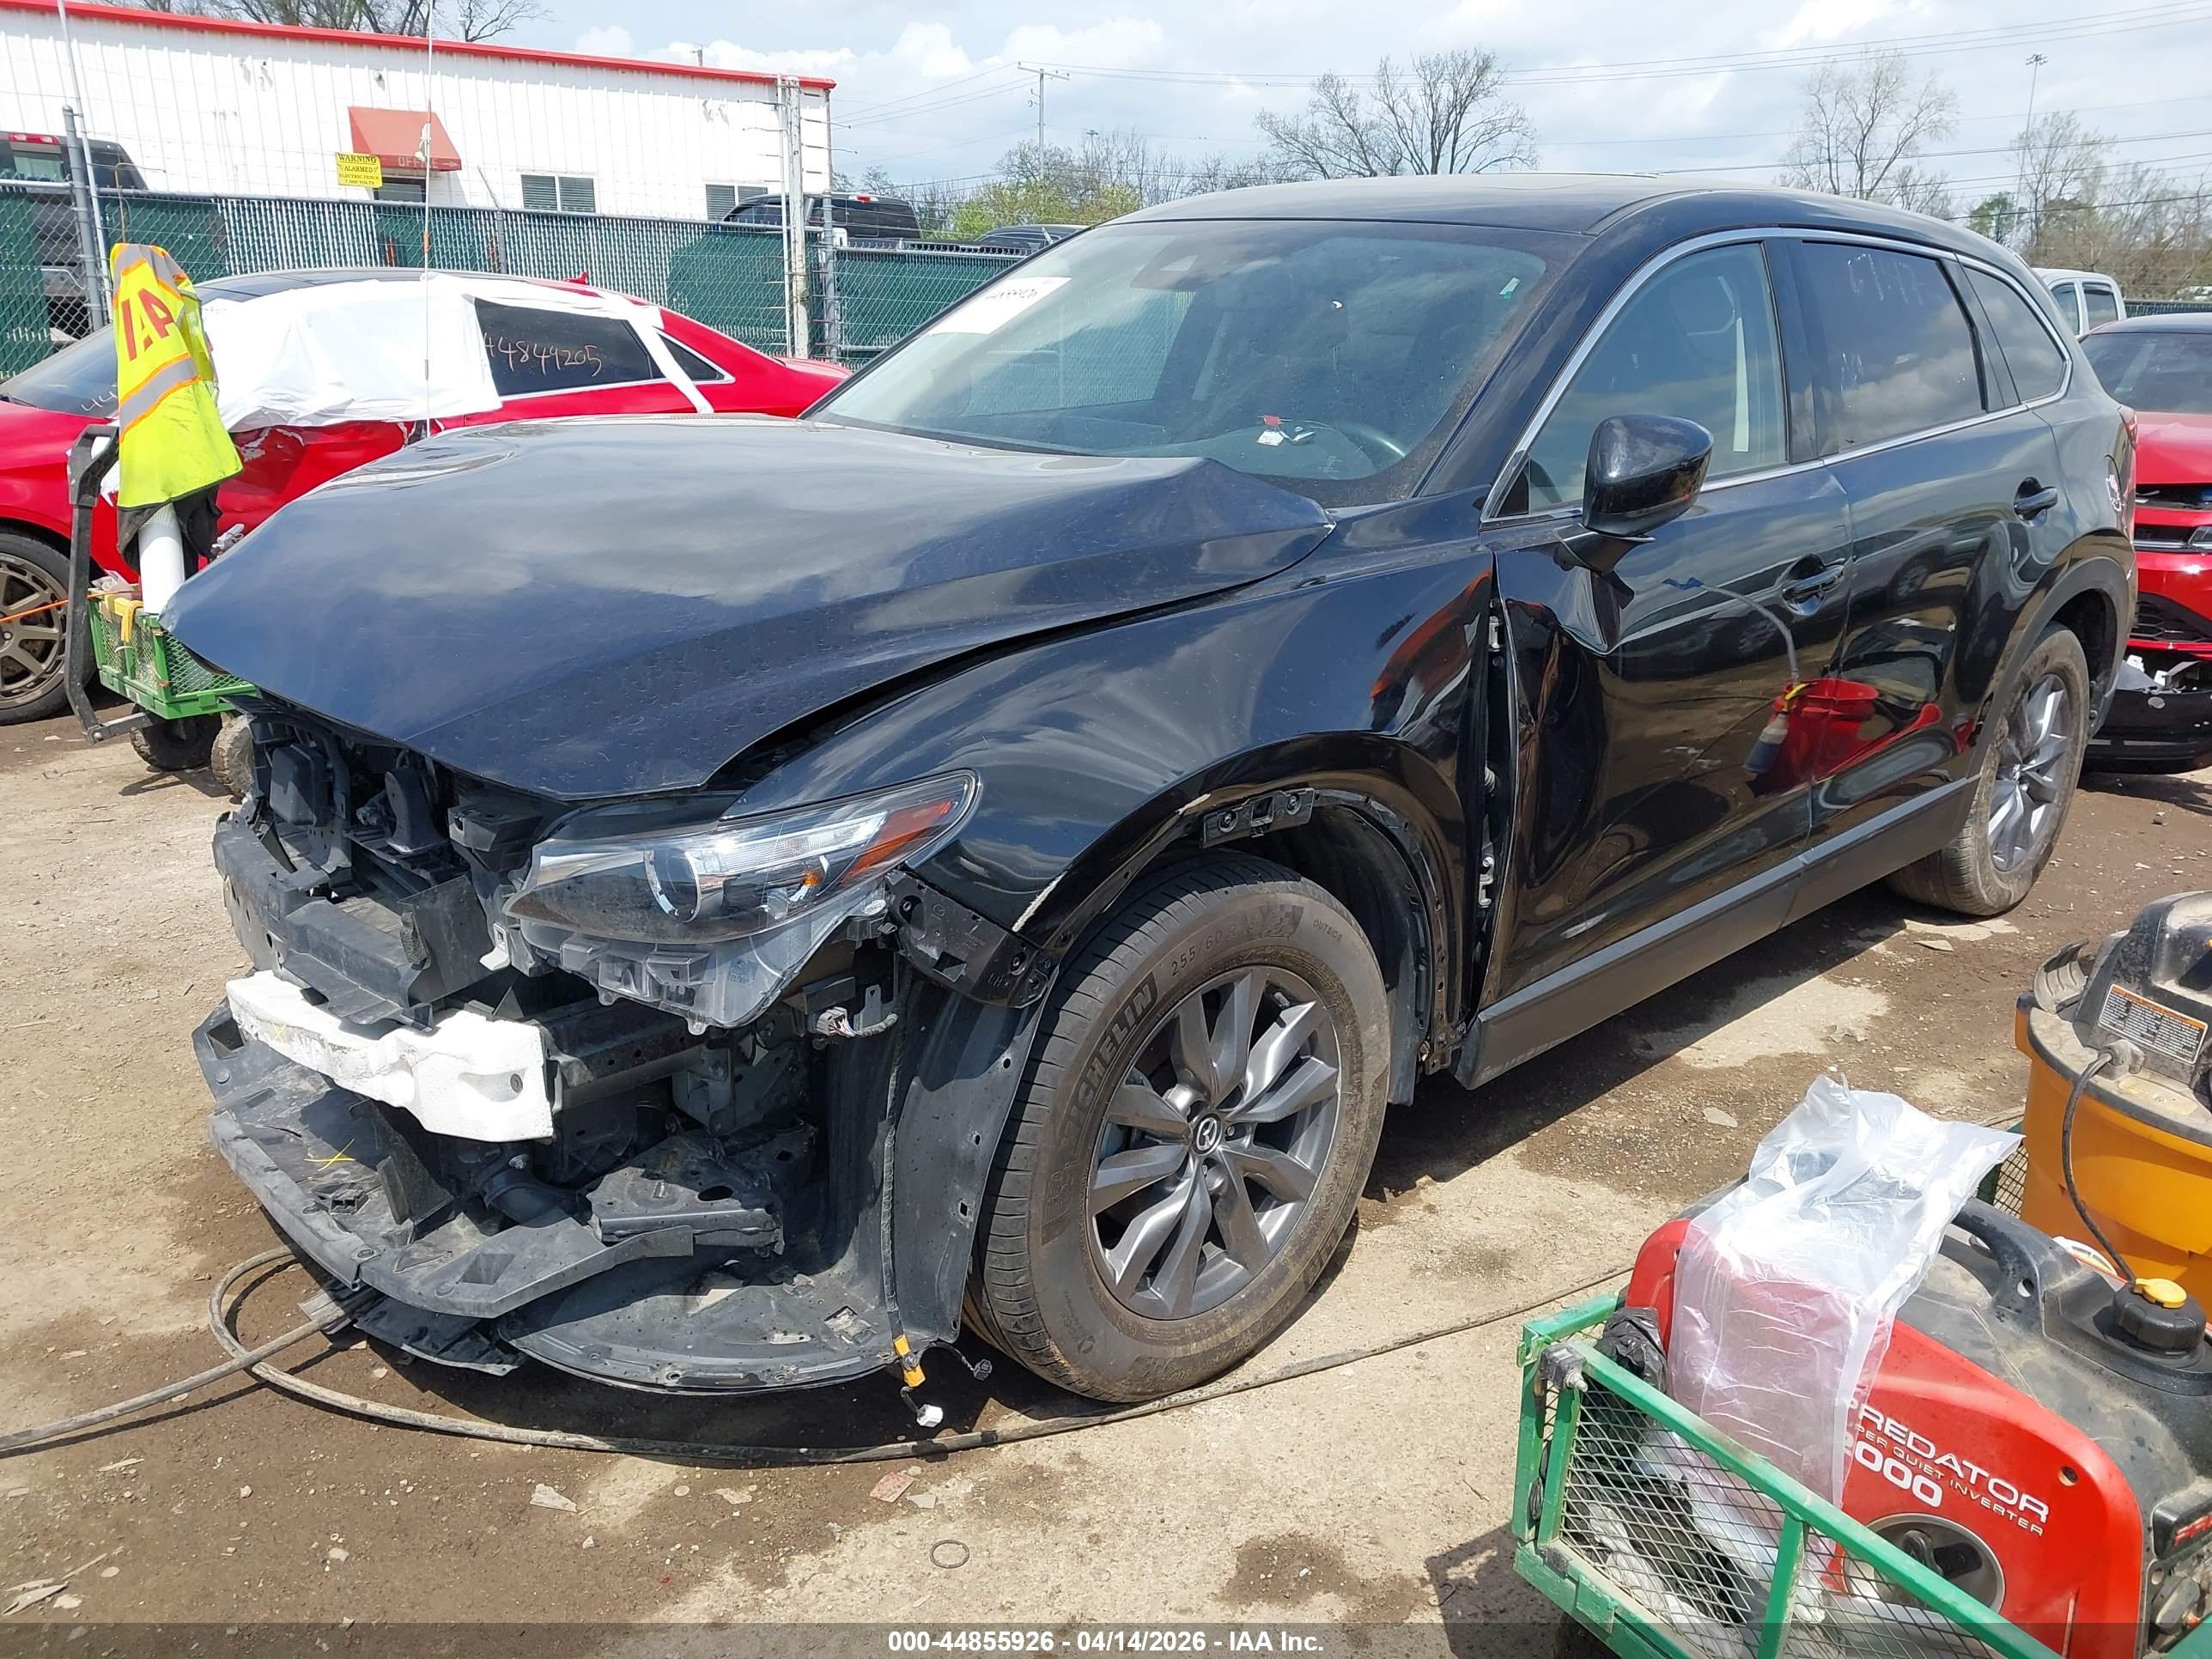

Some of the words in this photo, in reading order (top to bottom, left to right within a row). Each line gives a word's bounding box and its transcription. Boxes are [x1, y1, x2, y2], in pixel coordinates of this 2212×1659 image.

[337, 153, 377, 163] WARNING
[483, 331, 603, 377] 44849205
[1312, 919, 1343, 944] OUTSIDE
[1855, 1423, 1888, 1449] PER
[1893, 1445, 1945, 1480] QUIET
[1949, 1478, 2045, 1538] INVERTER
